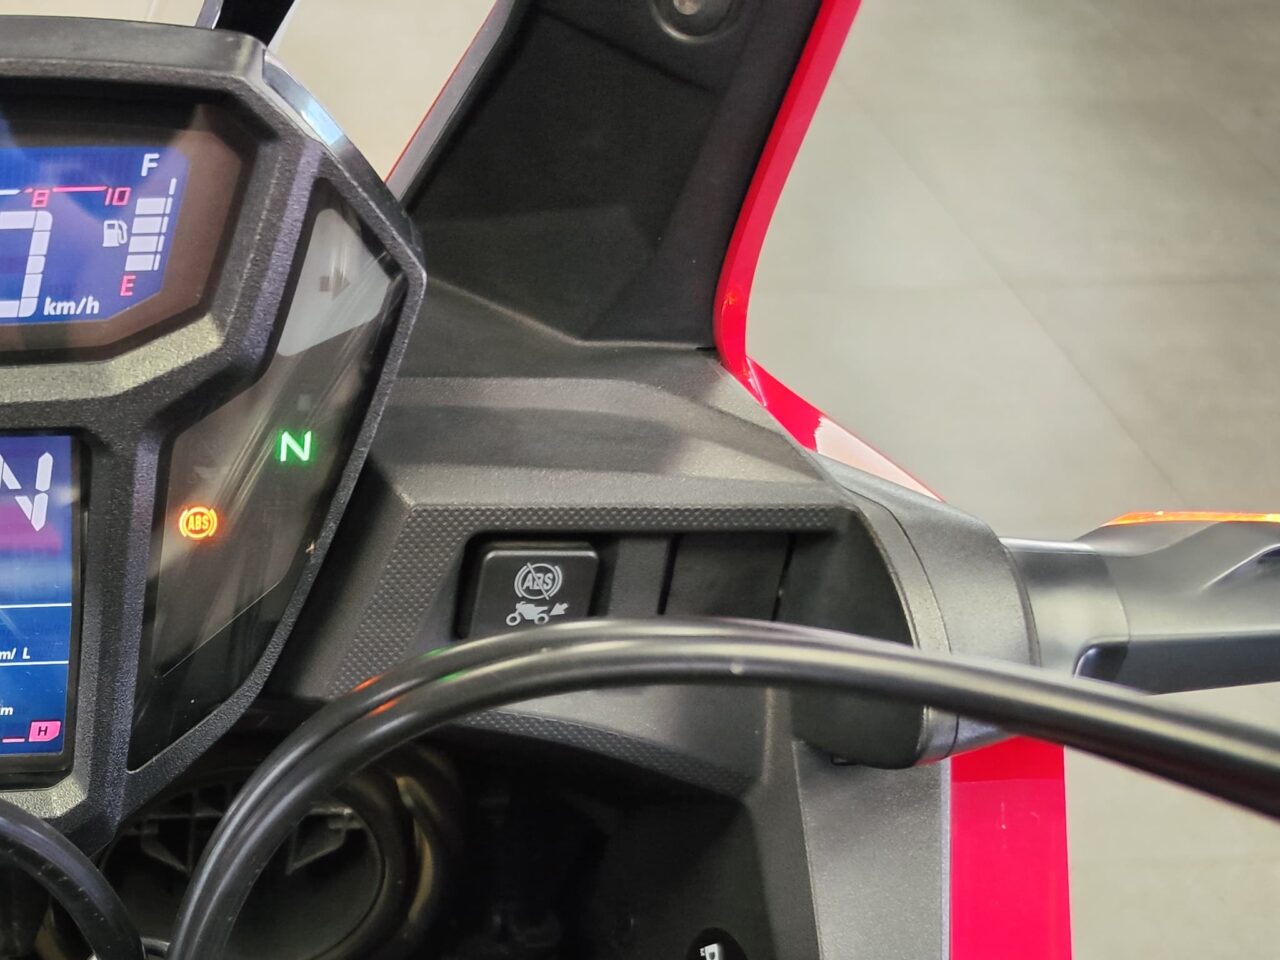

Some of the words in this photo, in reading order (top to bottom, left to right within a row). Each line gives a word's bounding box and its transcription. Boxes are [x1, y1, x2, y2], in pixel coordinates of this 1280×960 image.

[141, 153, 160, 176] F
[31, 190, 49, 208] 8
[105, 188, 131, 206] 10
[120, 276, 136, 296] E
[43, 297, 100, 316] km/h
[280, 430, 312, 462] N
[187, 514, 210, 531] ABS
[522, 573, 554, 590] ABS
[37, 726, 48, 737] H
